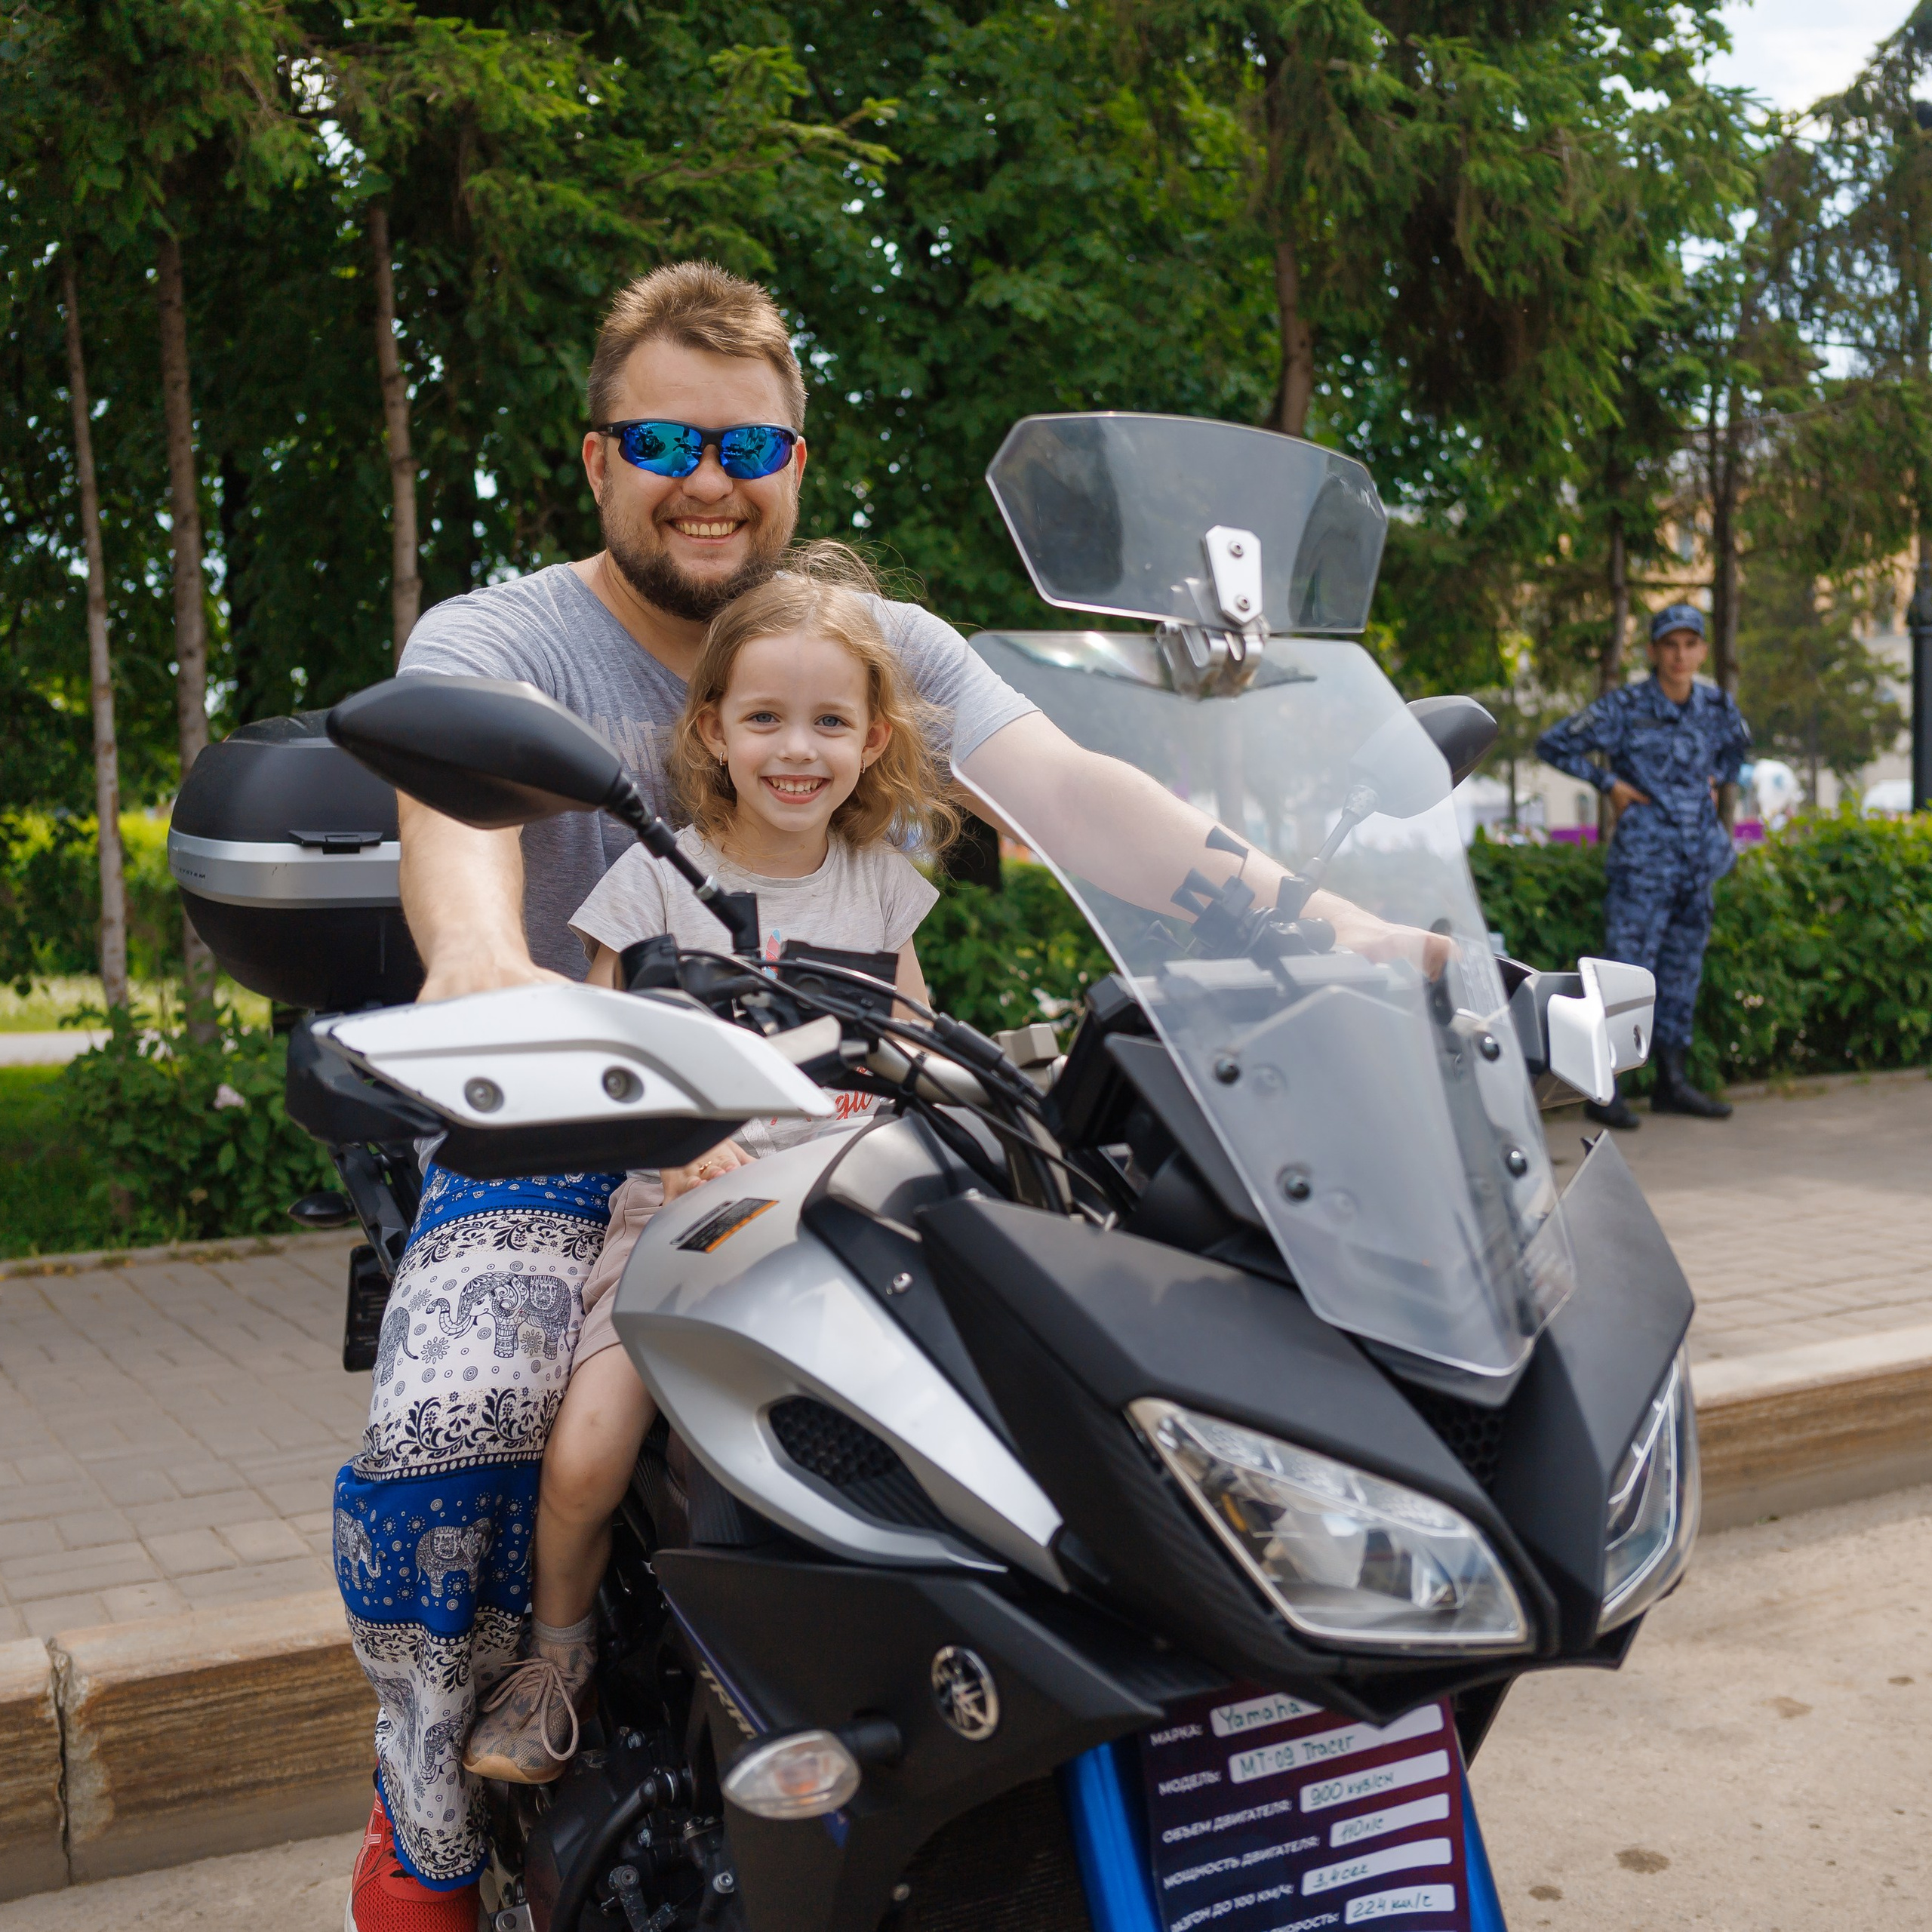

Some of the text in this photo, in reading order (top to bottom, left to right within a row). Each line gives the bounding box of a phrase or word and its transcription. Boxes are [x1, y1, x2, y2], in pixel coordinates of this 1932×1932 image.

[1217, 1698, 1300, 1730] Yamaha
[1239, 1735, 1355, 1779] MT-09 Tracer
[1310, 1782, 1343, 1806] 900
[1163, 1835, 1320, 1890] МОЩНОСТЬ ДВИГАТЕЛЯ:
[1352, 1897, 1386, 1918] 224
